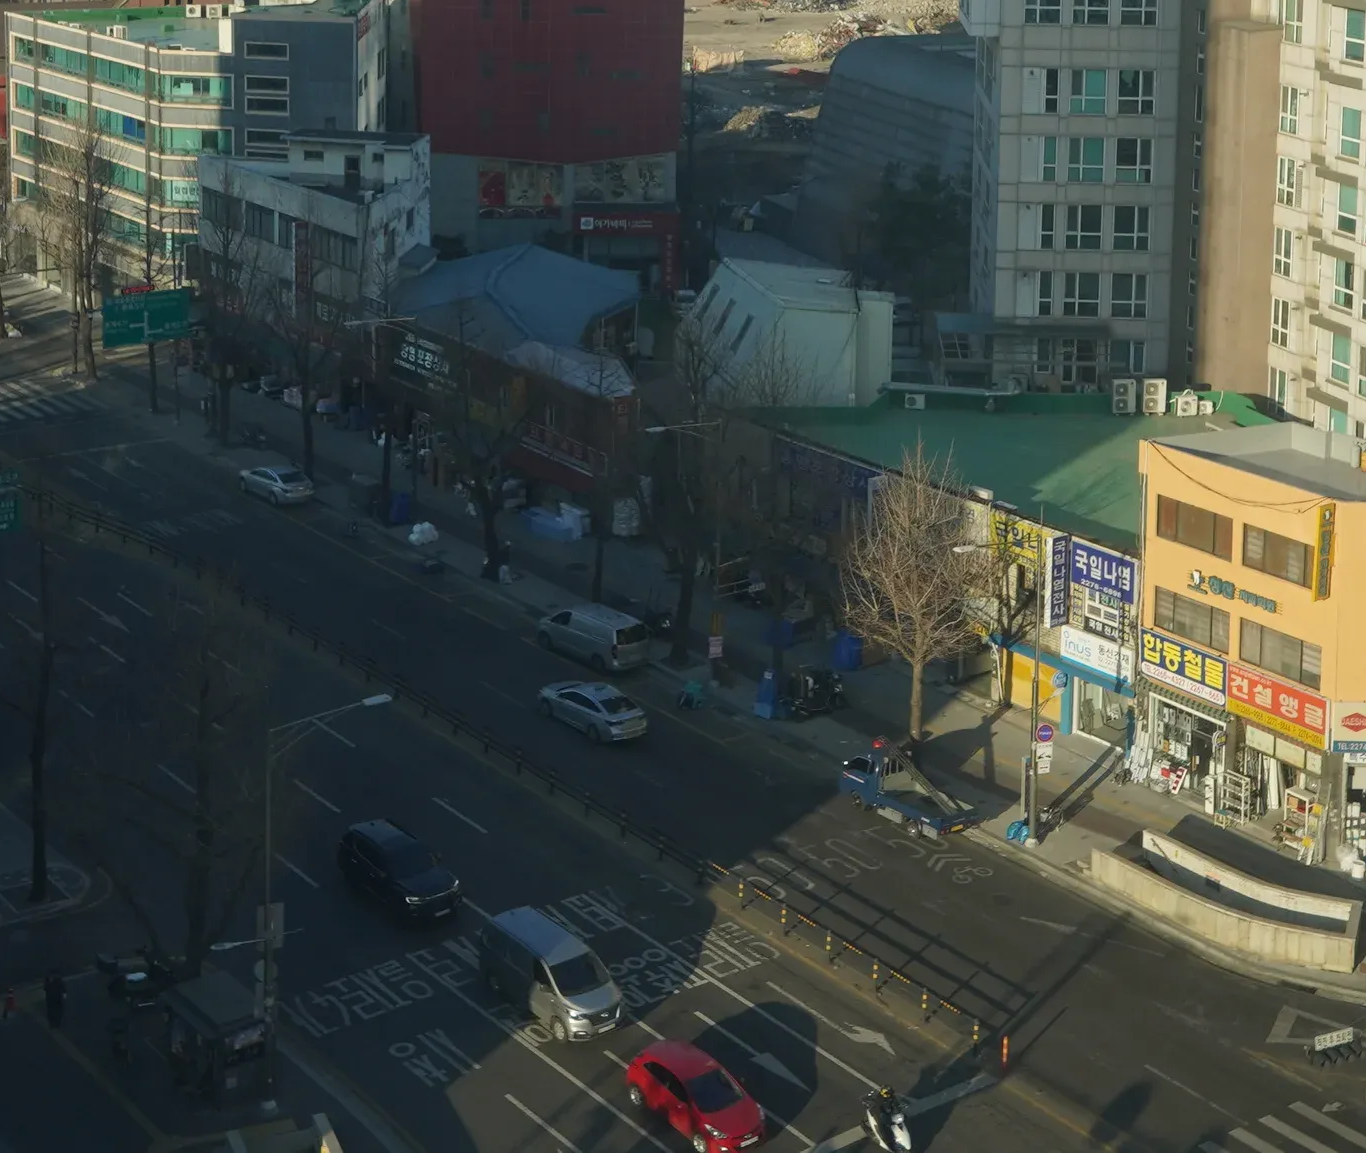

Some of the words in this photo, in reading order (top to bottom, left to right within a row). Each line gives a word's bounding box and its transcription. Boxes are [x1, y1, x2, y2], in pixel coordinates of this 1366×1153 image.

[1053, 540, 1067, 616] 국일나염전사
[1075, 549, 1131, 591] 국일나염
[1064, 639, 1092, 657] inus
[1143, 633, 1224, 690] 합동철물
[1230, 674, 1324, 729] 건설앵글
